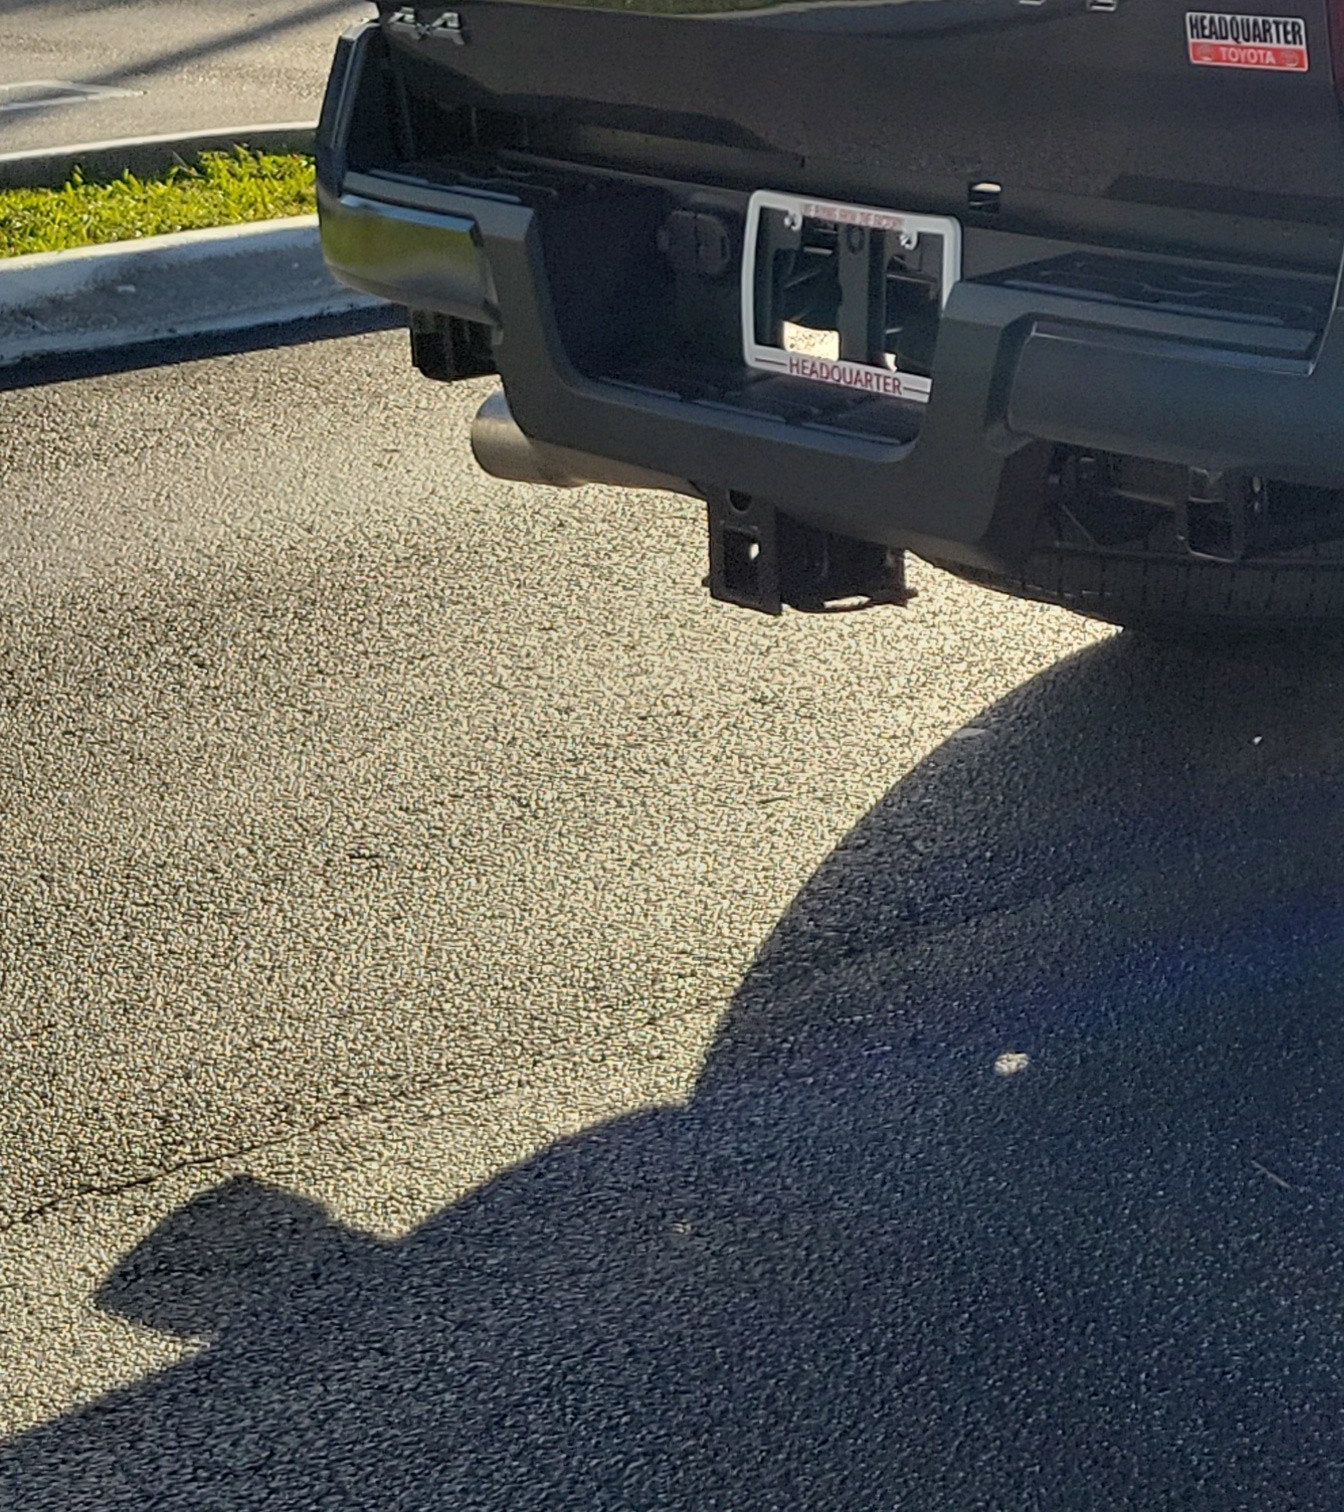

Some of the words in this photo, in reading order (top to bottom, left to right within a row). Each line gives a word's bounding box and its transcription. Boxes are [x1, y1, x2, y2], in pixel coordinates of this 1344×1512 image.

[1188, 14, 1304, 46] HEADQUARTER
[1218, 47, 1276, 65] TOYOTA
[788, 356, 903, 396] HEADQUARTER
